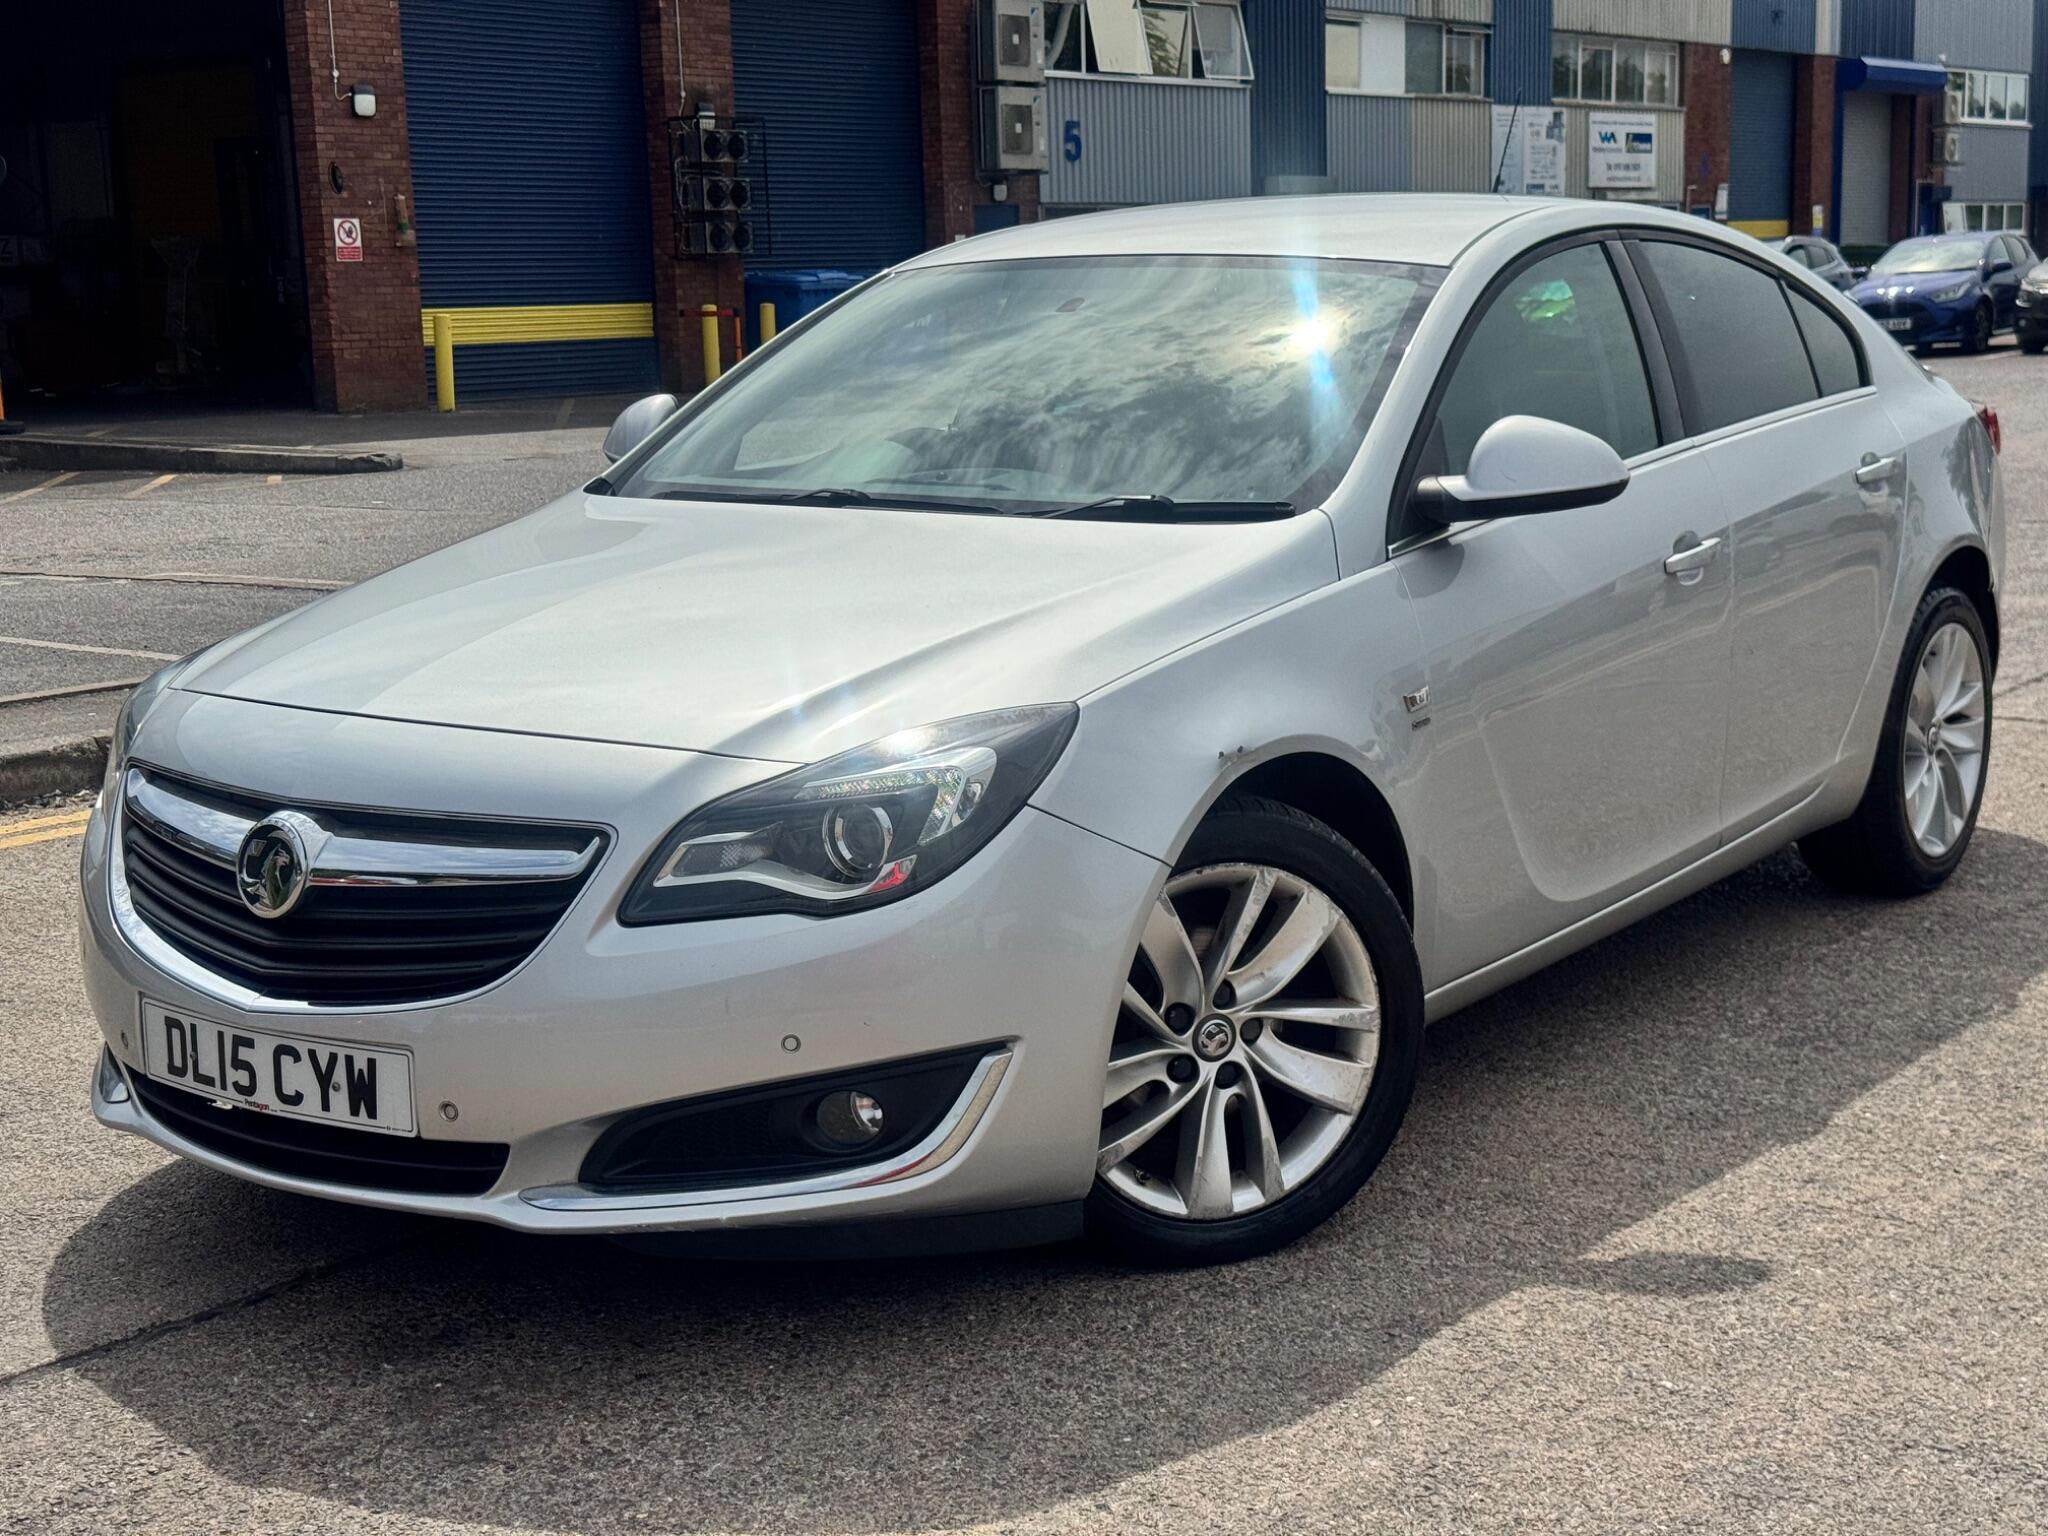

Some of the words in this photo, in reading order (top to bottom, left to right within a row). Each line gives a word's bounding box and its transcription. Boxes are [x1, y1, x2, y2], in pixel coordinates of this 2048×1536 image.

[1063, 120, 1083, 163] 5
[164, 1015, 258, 1097] DL15
[272, 1043, 378, 1120] CYW
